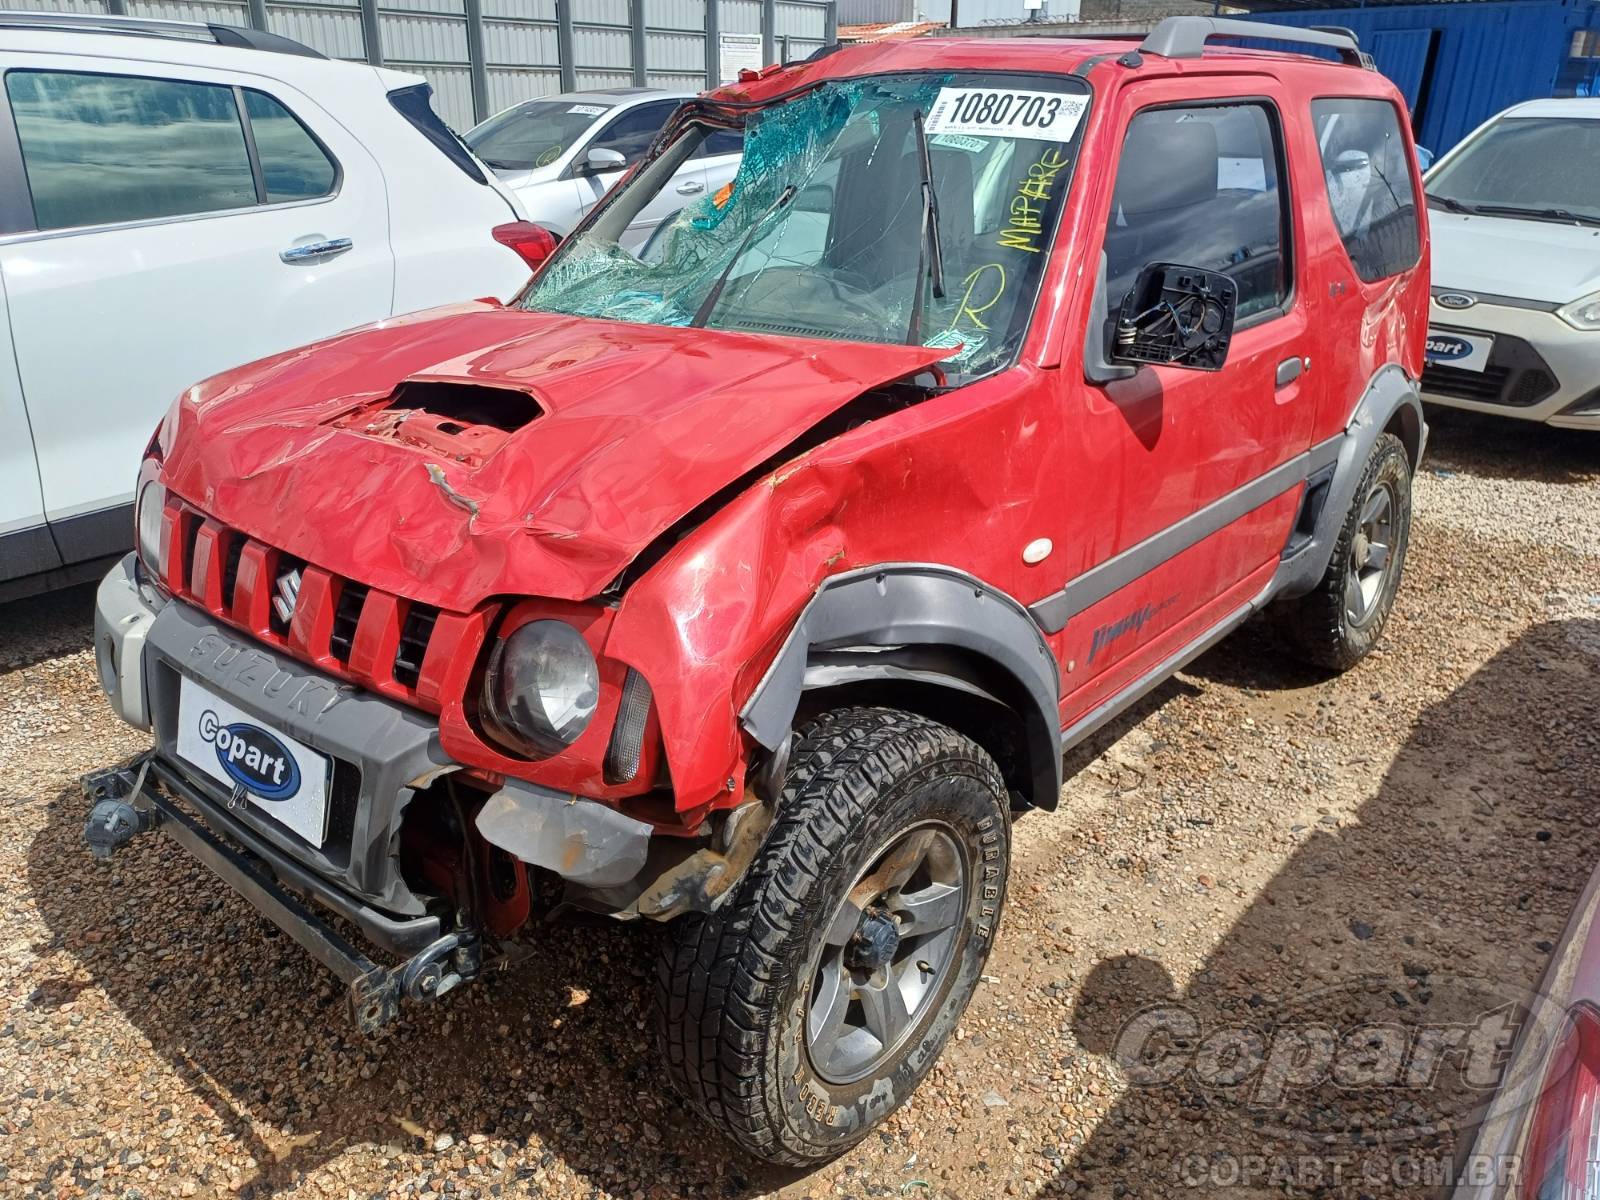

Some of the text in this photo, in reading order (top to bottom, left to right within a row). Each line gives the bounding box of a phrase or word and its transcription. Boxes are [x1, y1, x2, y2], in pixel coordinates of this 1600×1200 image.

[950, 93, 1062, 129] 1080703
[950, 263, 1006, 330] R
[1425, 340, 1462, 355] part
[190, 633, 342, 723] SUZUKI
[199, 710, 286, 785] Copart
